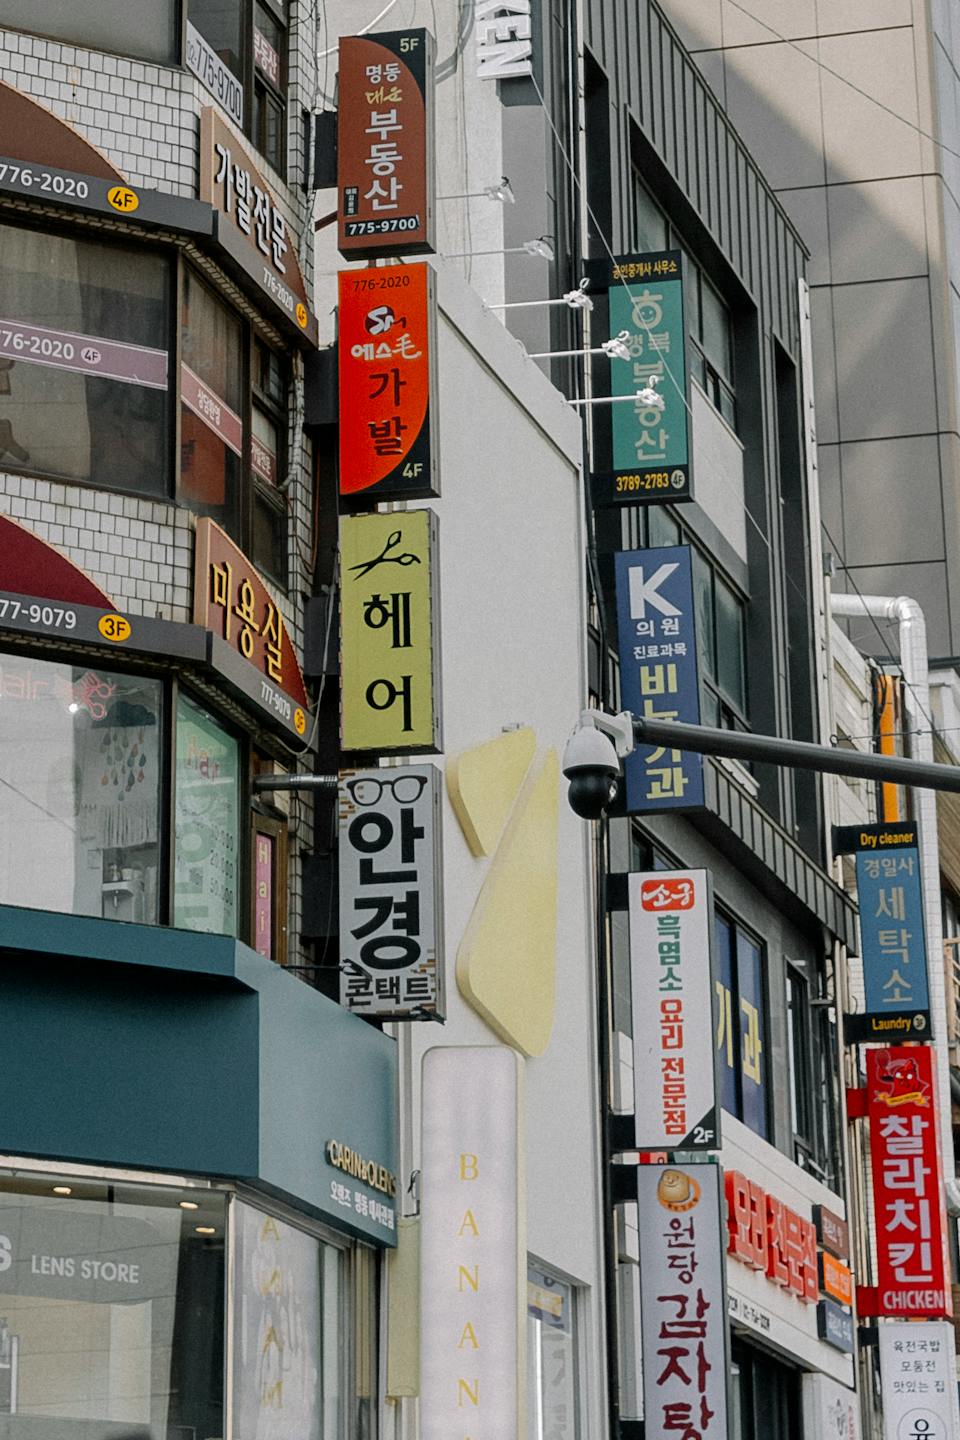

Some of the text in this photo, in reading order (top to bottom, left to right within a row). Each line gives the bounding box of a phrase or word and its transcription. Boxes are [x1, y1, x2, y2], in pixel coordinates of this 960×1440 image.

[399, 37, 419, 53] 5F
[365, 63, 401, 84] 명동
[364, 109, 403, 210] 부동산
[112, 189, 135, 208] 4F
[348, 218, 416, 236] 775-9700
[654, 261, 677, 274] 사무소
[263, 267, 294, 312] 776-2020
[353, 275, 410, 292] 776-2020
[368, 368, 407, 456] 가발
[402, 462, 423, 478] 4F
[616, 471, 669, 492] 3789-2783
[628, 562, 683, 620] K
[104, 617, 127, 638] 3F
[213, 561, 283, 684] 미용실
[636, 618, 680, 637] 의원
[363, 592, 414, 732] 헤어
[633, 641, 687, 660] 진료과목
[260, 681, 291, 720] 777-9079
[860, 830, 914, 849] Dry cleaner
[864, 857, 915, 880] 경일사
[348, 808, 424, 970] 안경
[657, 915, 683, 991] 흑염소
[875, 886, 913, 1003] 세탁소
[345, 975, 432, 1006] 콘택트
[660, 999, 684, 1050] 요리
[871, 1016, 912, 1033] Laundry
[662, 1057, 687, 1135] 전문점
[693, 1126, 715, 1144] 2F
[31, 1254, 76, 1279] LENS
[81, 1260, 140, 1285] STORE
[458, 1154, 480, 1440] BANAN
[883, 1290, 945, 1309] CHICKEN
